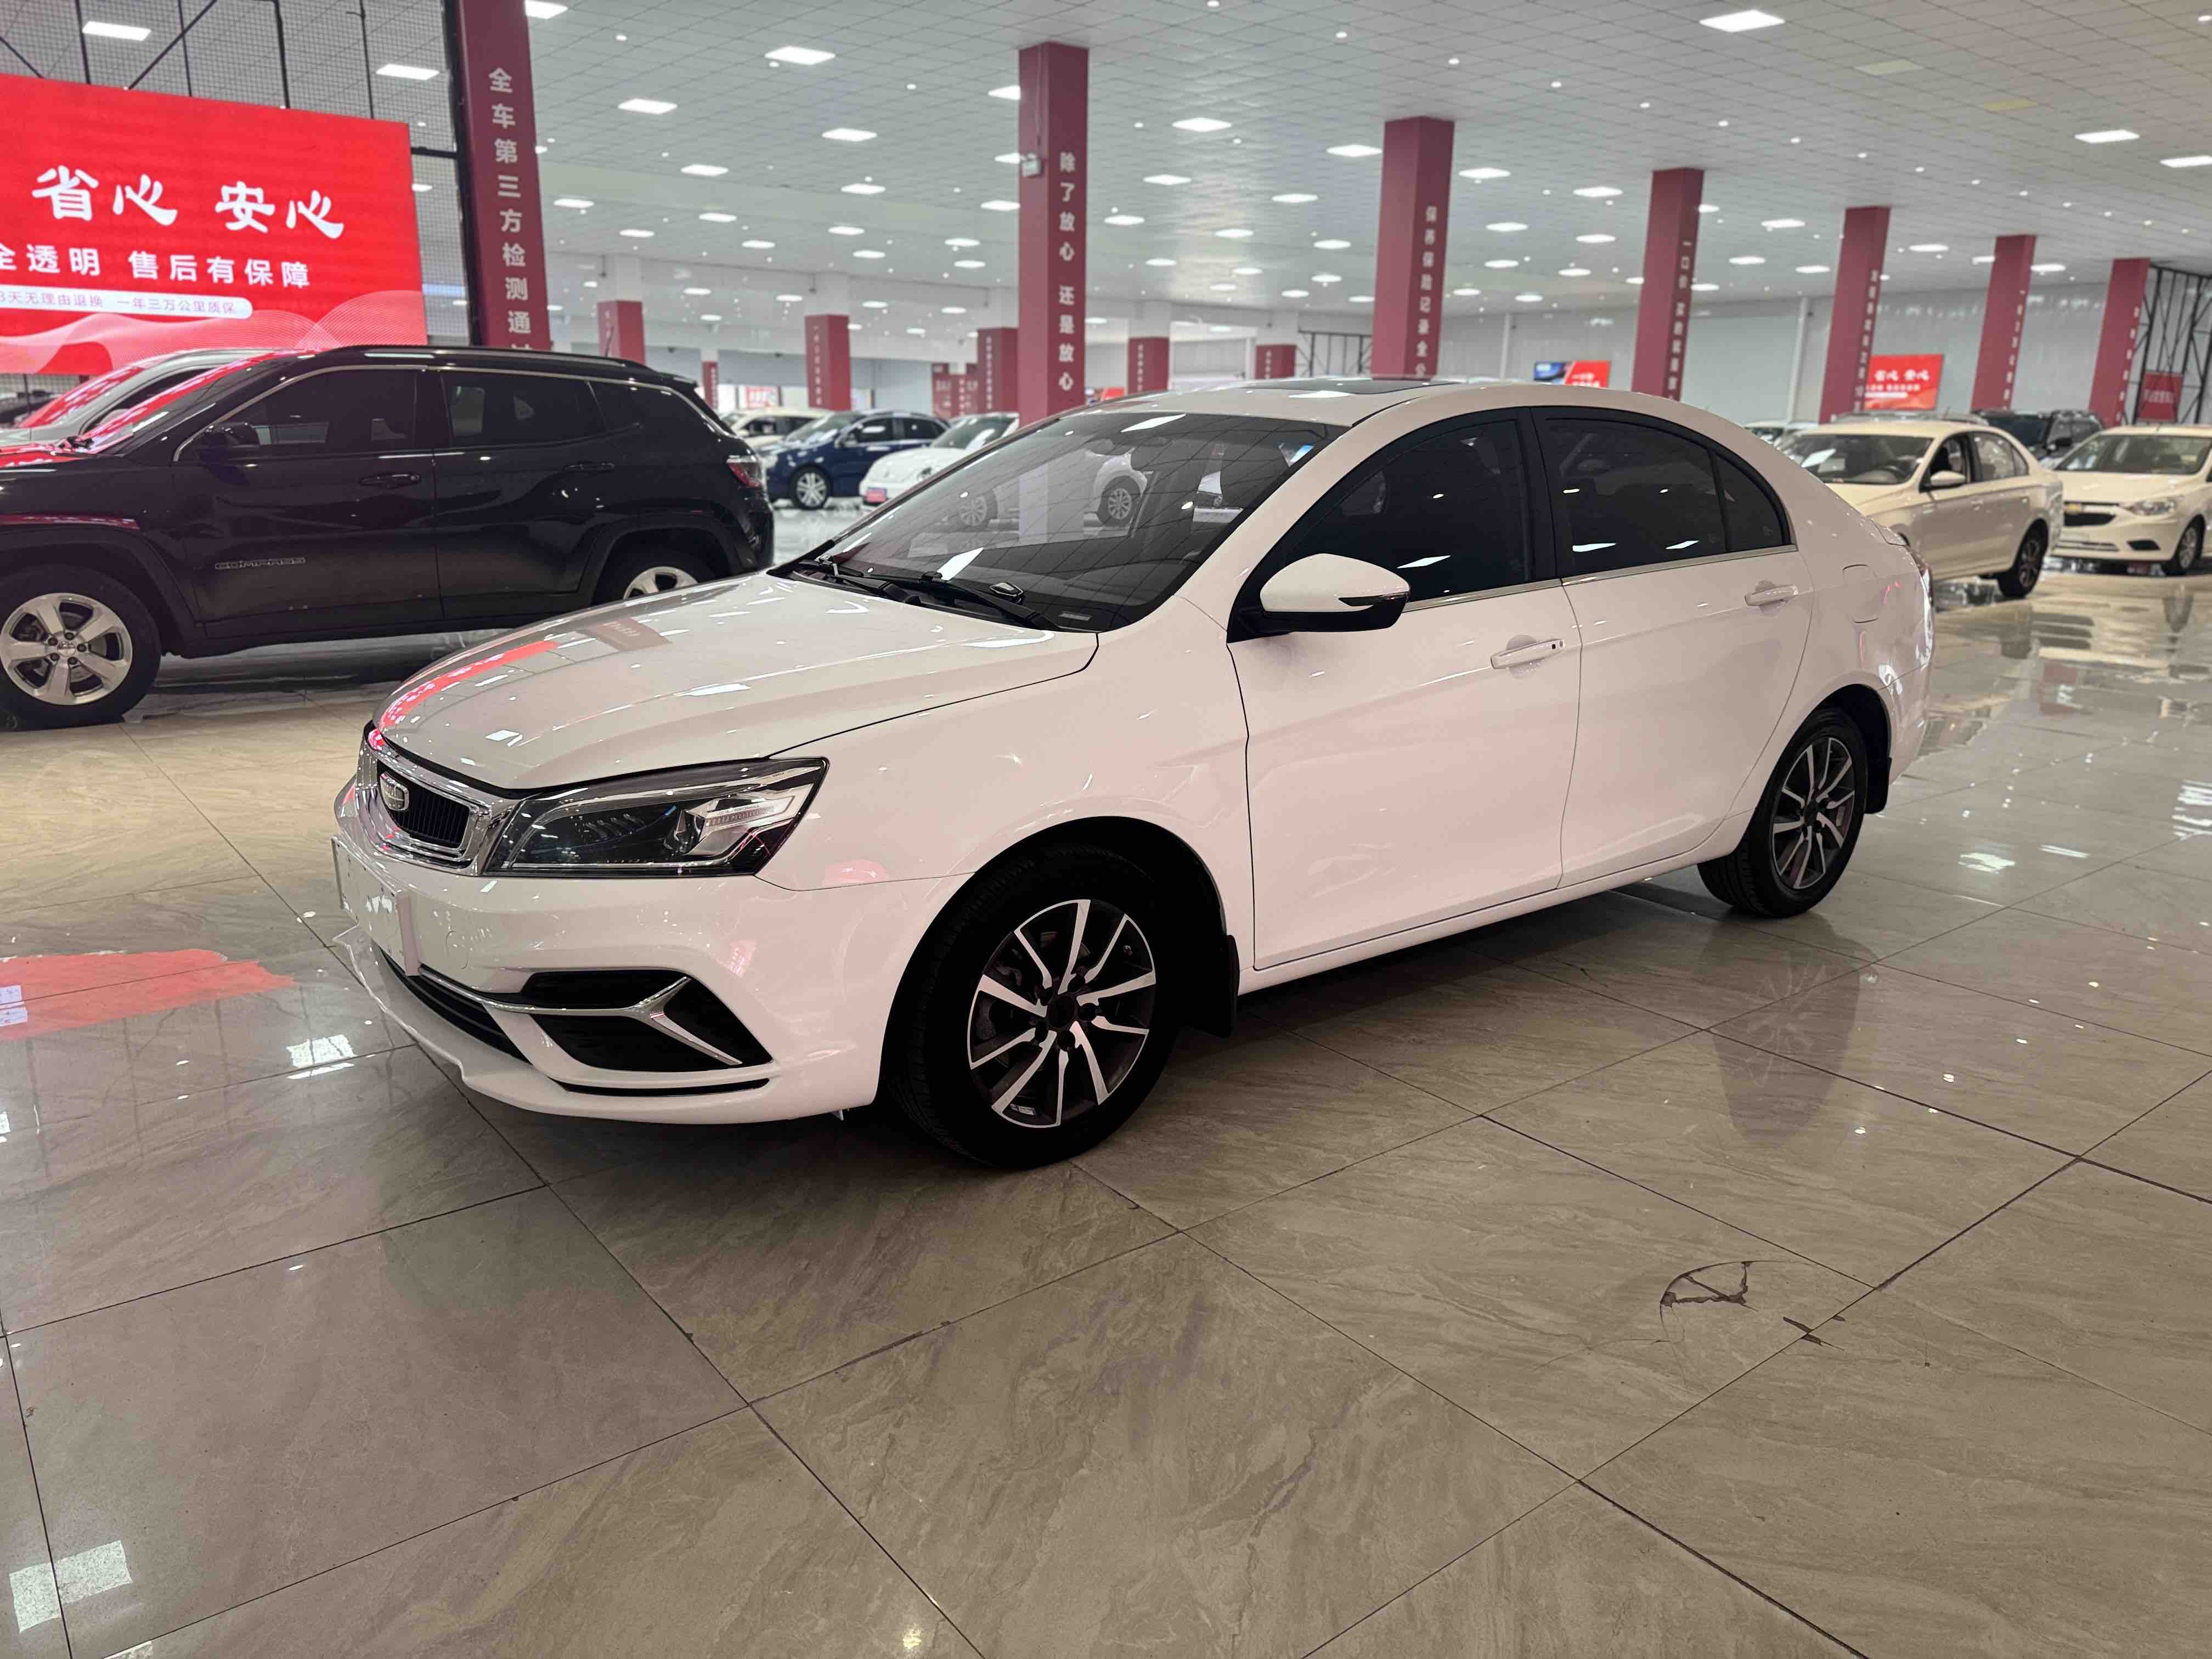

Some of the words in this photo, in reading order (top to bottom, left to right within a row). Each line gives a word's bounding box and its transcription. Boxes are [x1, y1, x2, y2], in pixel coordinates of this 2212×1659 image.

[32, 165, 178, 225] 省心
[215, 181, 344, 239] 安心
[489, 67, 533, 349] 全车第三方检测通
[1059, 151, 1075, 261] 除了放心
[117, 298, 236, 314] 一年三万公里质保
[128, 251, 310, 288] 售后有保障
[1058, 285, 1075, 391] 还是放心
